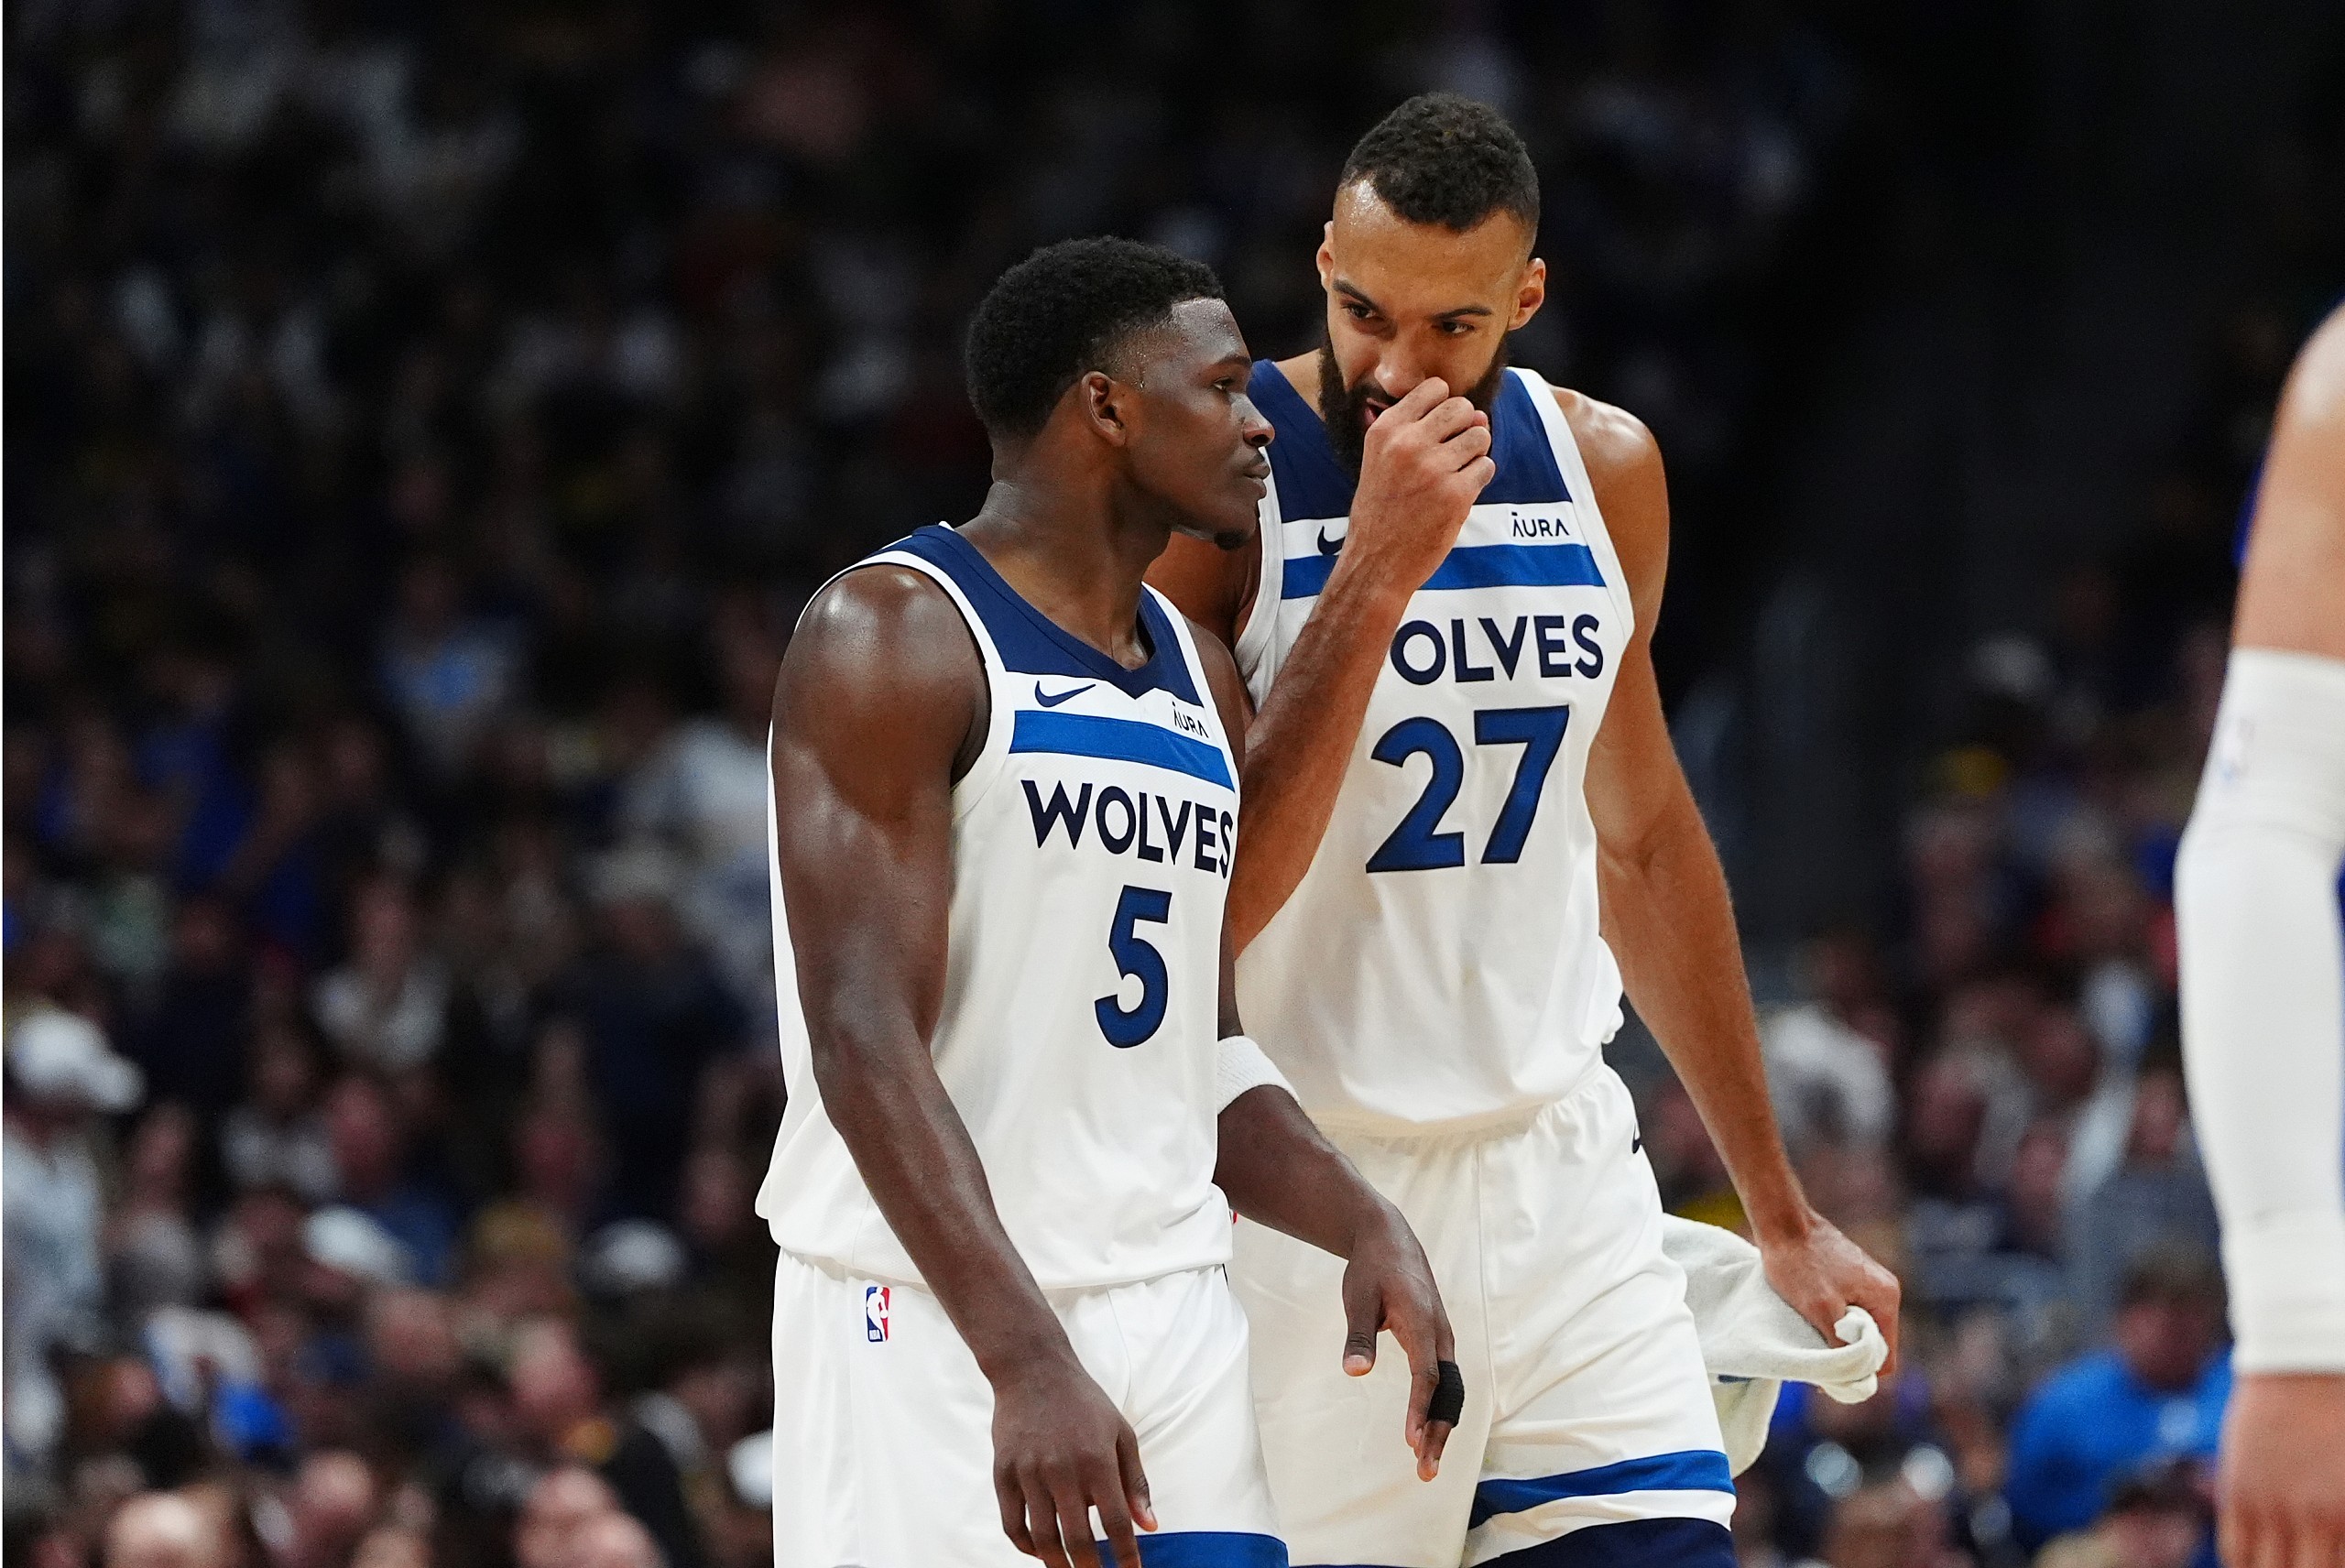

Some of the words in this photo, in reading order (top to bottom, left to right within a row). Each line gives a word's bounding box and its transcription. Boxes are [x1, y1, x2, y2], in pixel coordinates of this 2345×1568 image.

[1390, 614, 1604, 686] OLVES
[1020, 779, 1235, 880] WOLVES
[1366, 704, 1569, 874] 27
[1094, 884, 1172, 1049] 5
